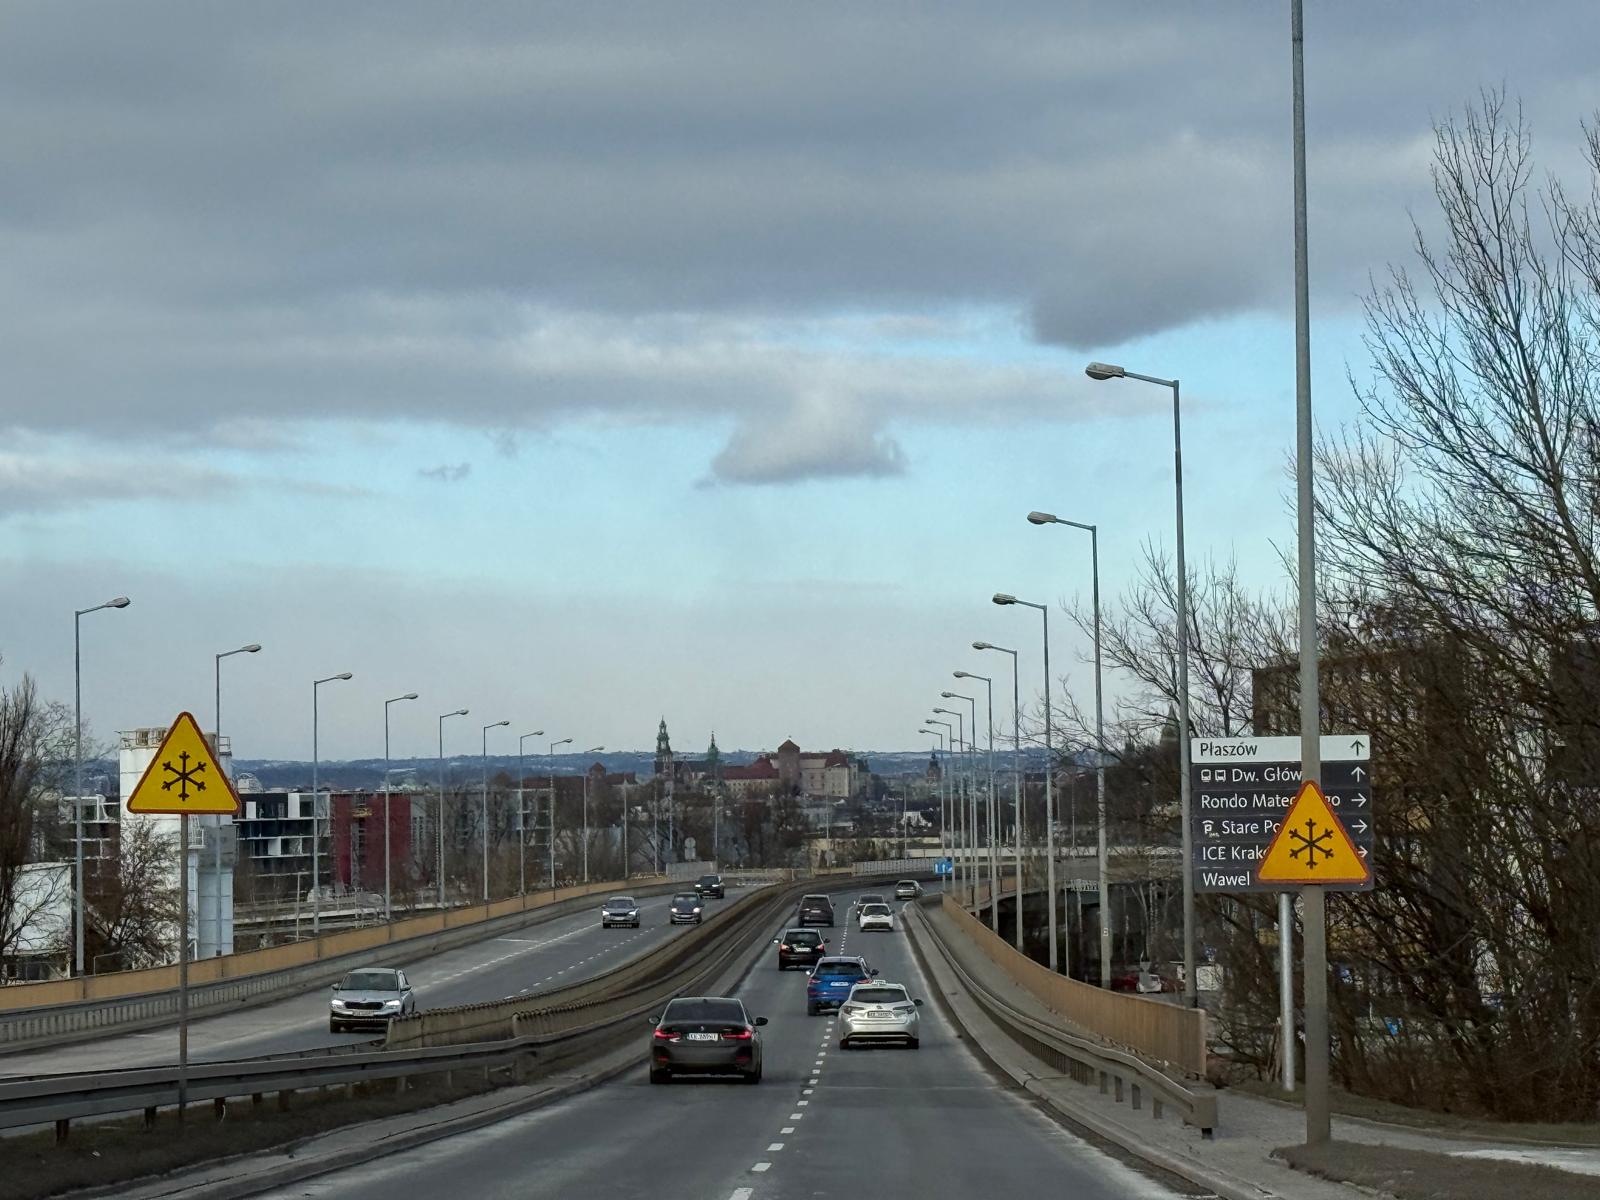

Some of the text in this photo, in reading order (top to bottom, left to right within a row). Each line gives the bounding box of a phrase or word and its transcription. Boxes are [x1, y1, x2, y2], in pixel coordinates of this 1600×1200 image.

[1200, 741, 1258, 757] Płaszów
[1232, 766, 1303, 782] Dw. Głów
[1201, 793, 1248, 809] Rondo
[1221, 820, 1259, 834] Stare
[1202, 845, 1270, 860] ICE Krak
[1202, 871, 1250, 886] Wawel
